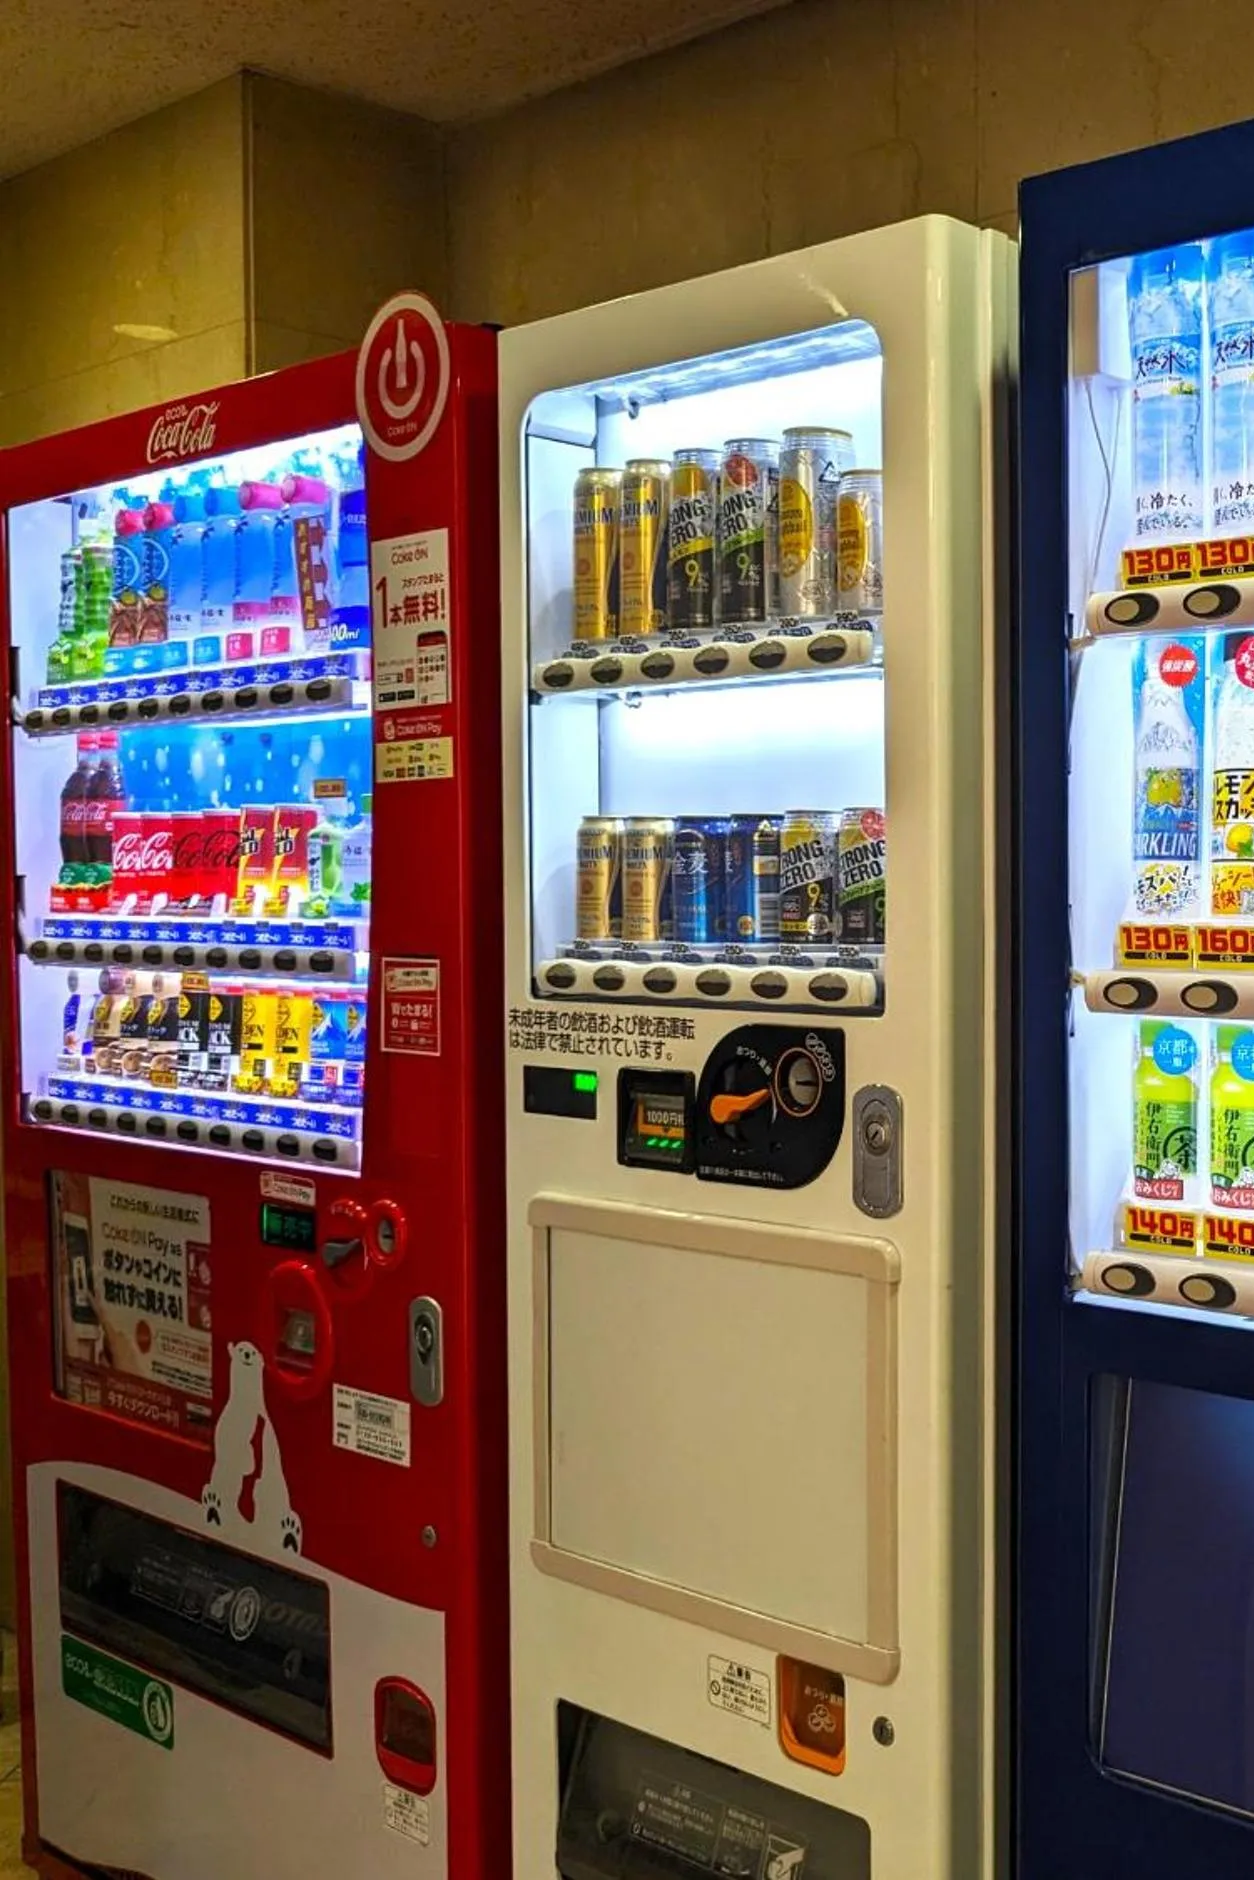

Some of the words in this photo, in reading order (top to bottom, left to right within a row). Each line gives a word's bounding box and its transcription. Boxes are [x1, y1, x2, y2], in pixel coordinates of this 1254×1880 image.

[1135, 349, 1187, 380] 天然水
[1123, 549, 1192, 576] 130円
[1121, 927, 1190, 950] 130円
[509, 1008, 695, 1040] 未成年者の飲酒および飲酒運転
[509, 1028, 673, 1061] は法律で禁止されています。
[1145, 1102, 1162, 1166] 伊右衛門
[1223, 1108, 1241, 1175] 伊右衛門
[1127, 1208, 1194, 1237] 140円
